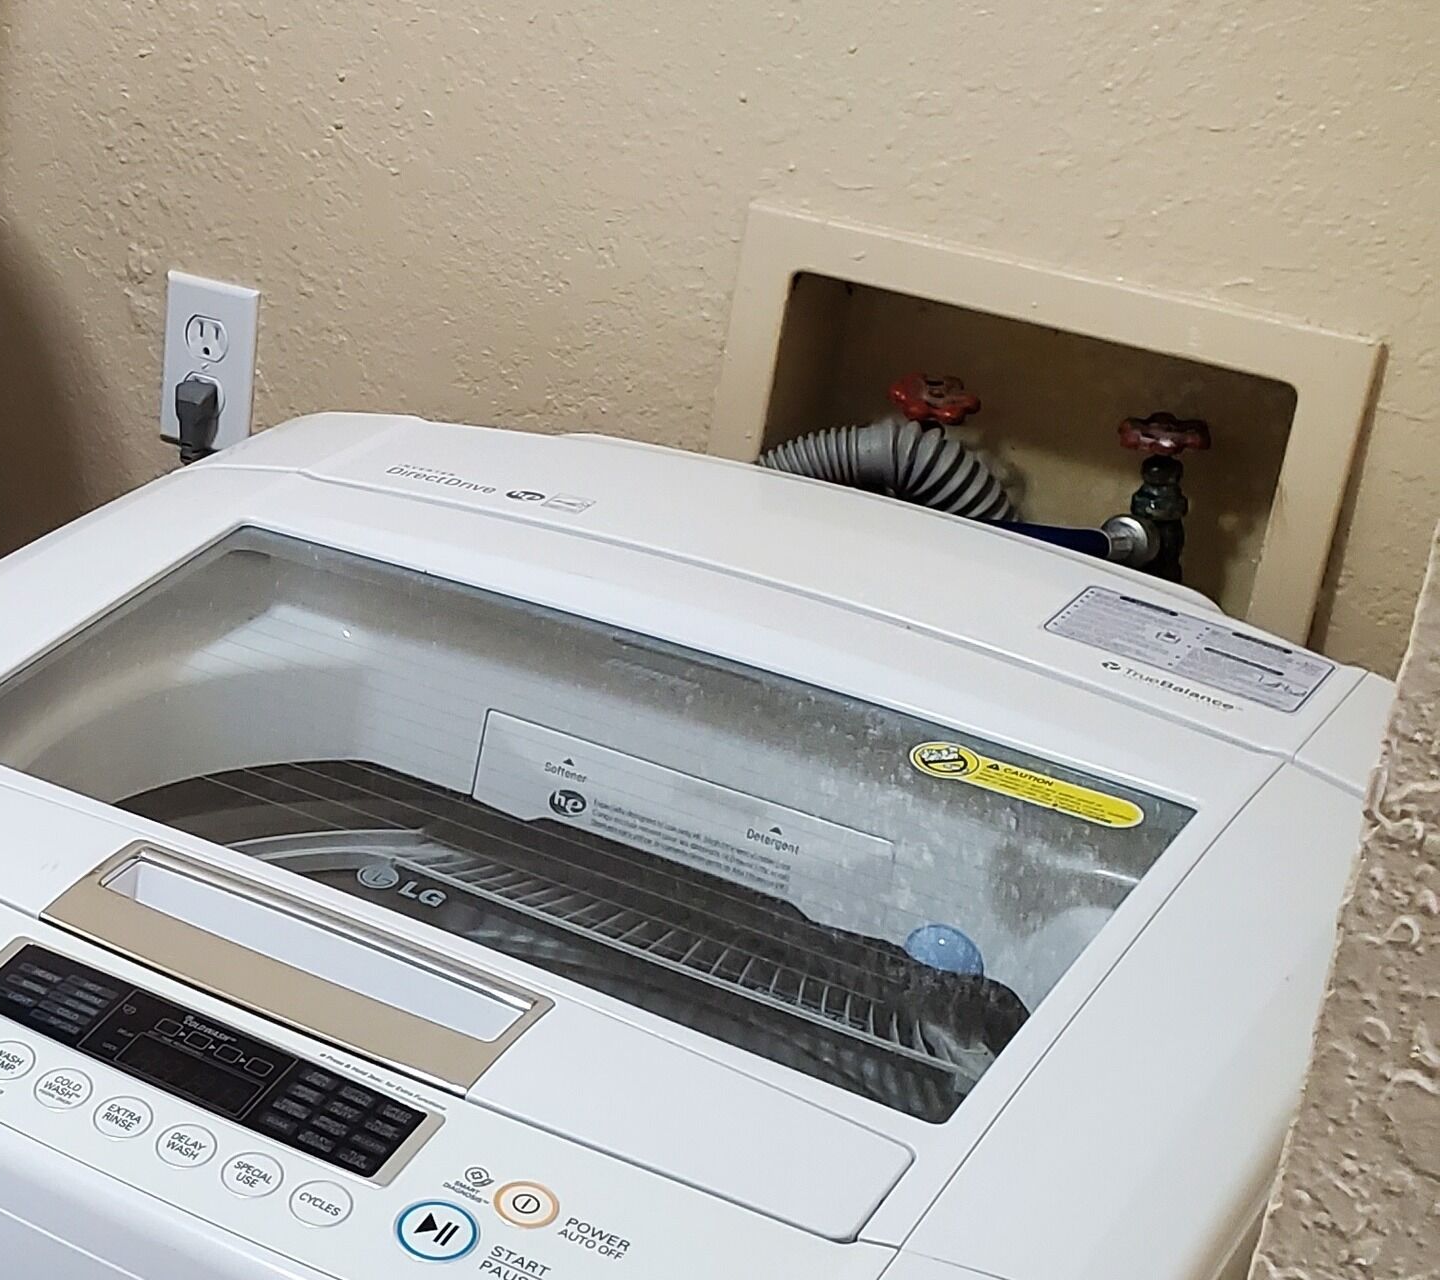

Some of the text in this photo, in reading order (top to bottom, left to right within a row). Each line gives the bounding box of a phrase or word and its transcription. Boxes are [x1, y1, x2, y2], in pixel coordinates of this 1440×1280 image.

[543, 760, 588, 784] Softener
[1004, 767, 1054, 787] CAUTION
[746, 827, 800, 856] Detergent
[397, 880, 448, 908] LG
[54, 1075, 82, 1092] COLD
[101, 1111, 135, 1132] RINSE
[106, 1102, 142, 1125] EXTRA
[165, 1139, 200, 1161] WASH
[170, 1130, 207, 1152] DELAY
[233, 1160, 274, 1185] SPECIAL
[235, 1172, 259, 1189] USE
[453, 1180, 480, 1195] SMART
[298, 1191, 342, 1218] CYCLES
[558, 1228, 625, 1262] AUTO OFF
[565, 1216, 632, 1252] POWER
[491, 1244, 552, 1278] START
